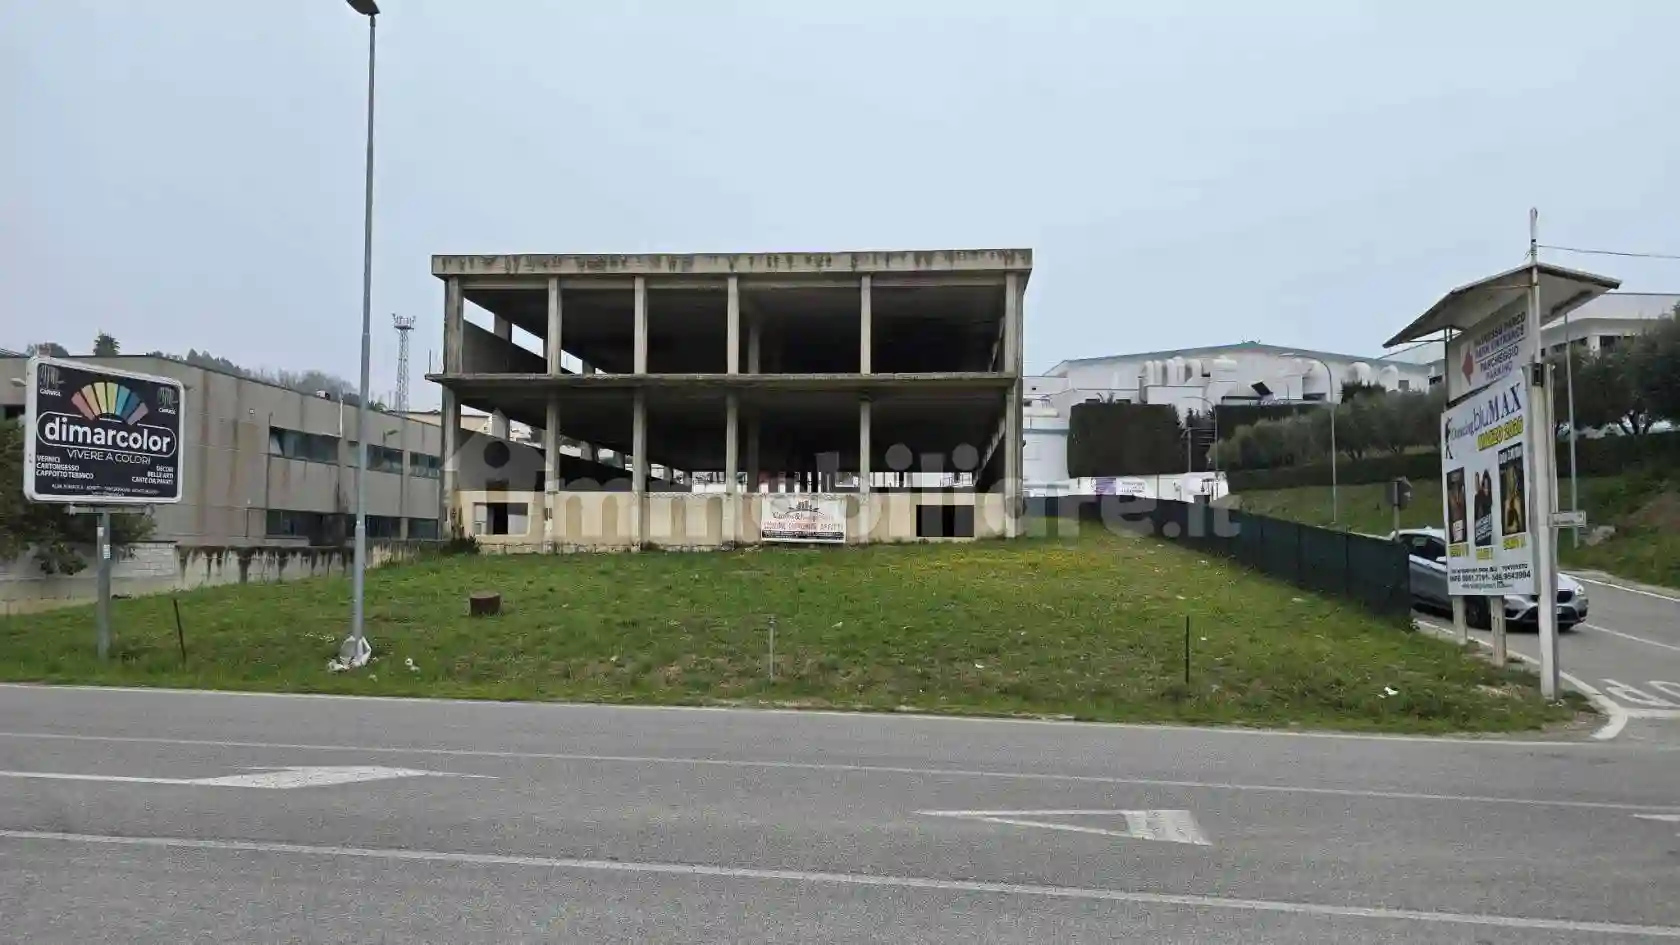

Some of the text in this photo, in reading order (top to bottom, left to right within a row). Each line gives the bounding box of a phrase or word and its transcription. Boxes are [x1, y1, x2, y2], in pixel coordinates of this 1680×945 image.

[44, 416, 171, 453] dimarcolor
[36, 455, 60, 463] VERNICI
[67, 449, 151, 465] VIVERE A COLORI
[36, 462, 80, 472] CARTONGESSO
[36, 470, 94, 479] CAPPOTTO TERMICO
